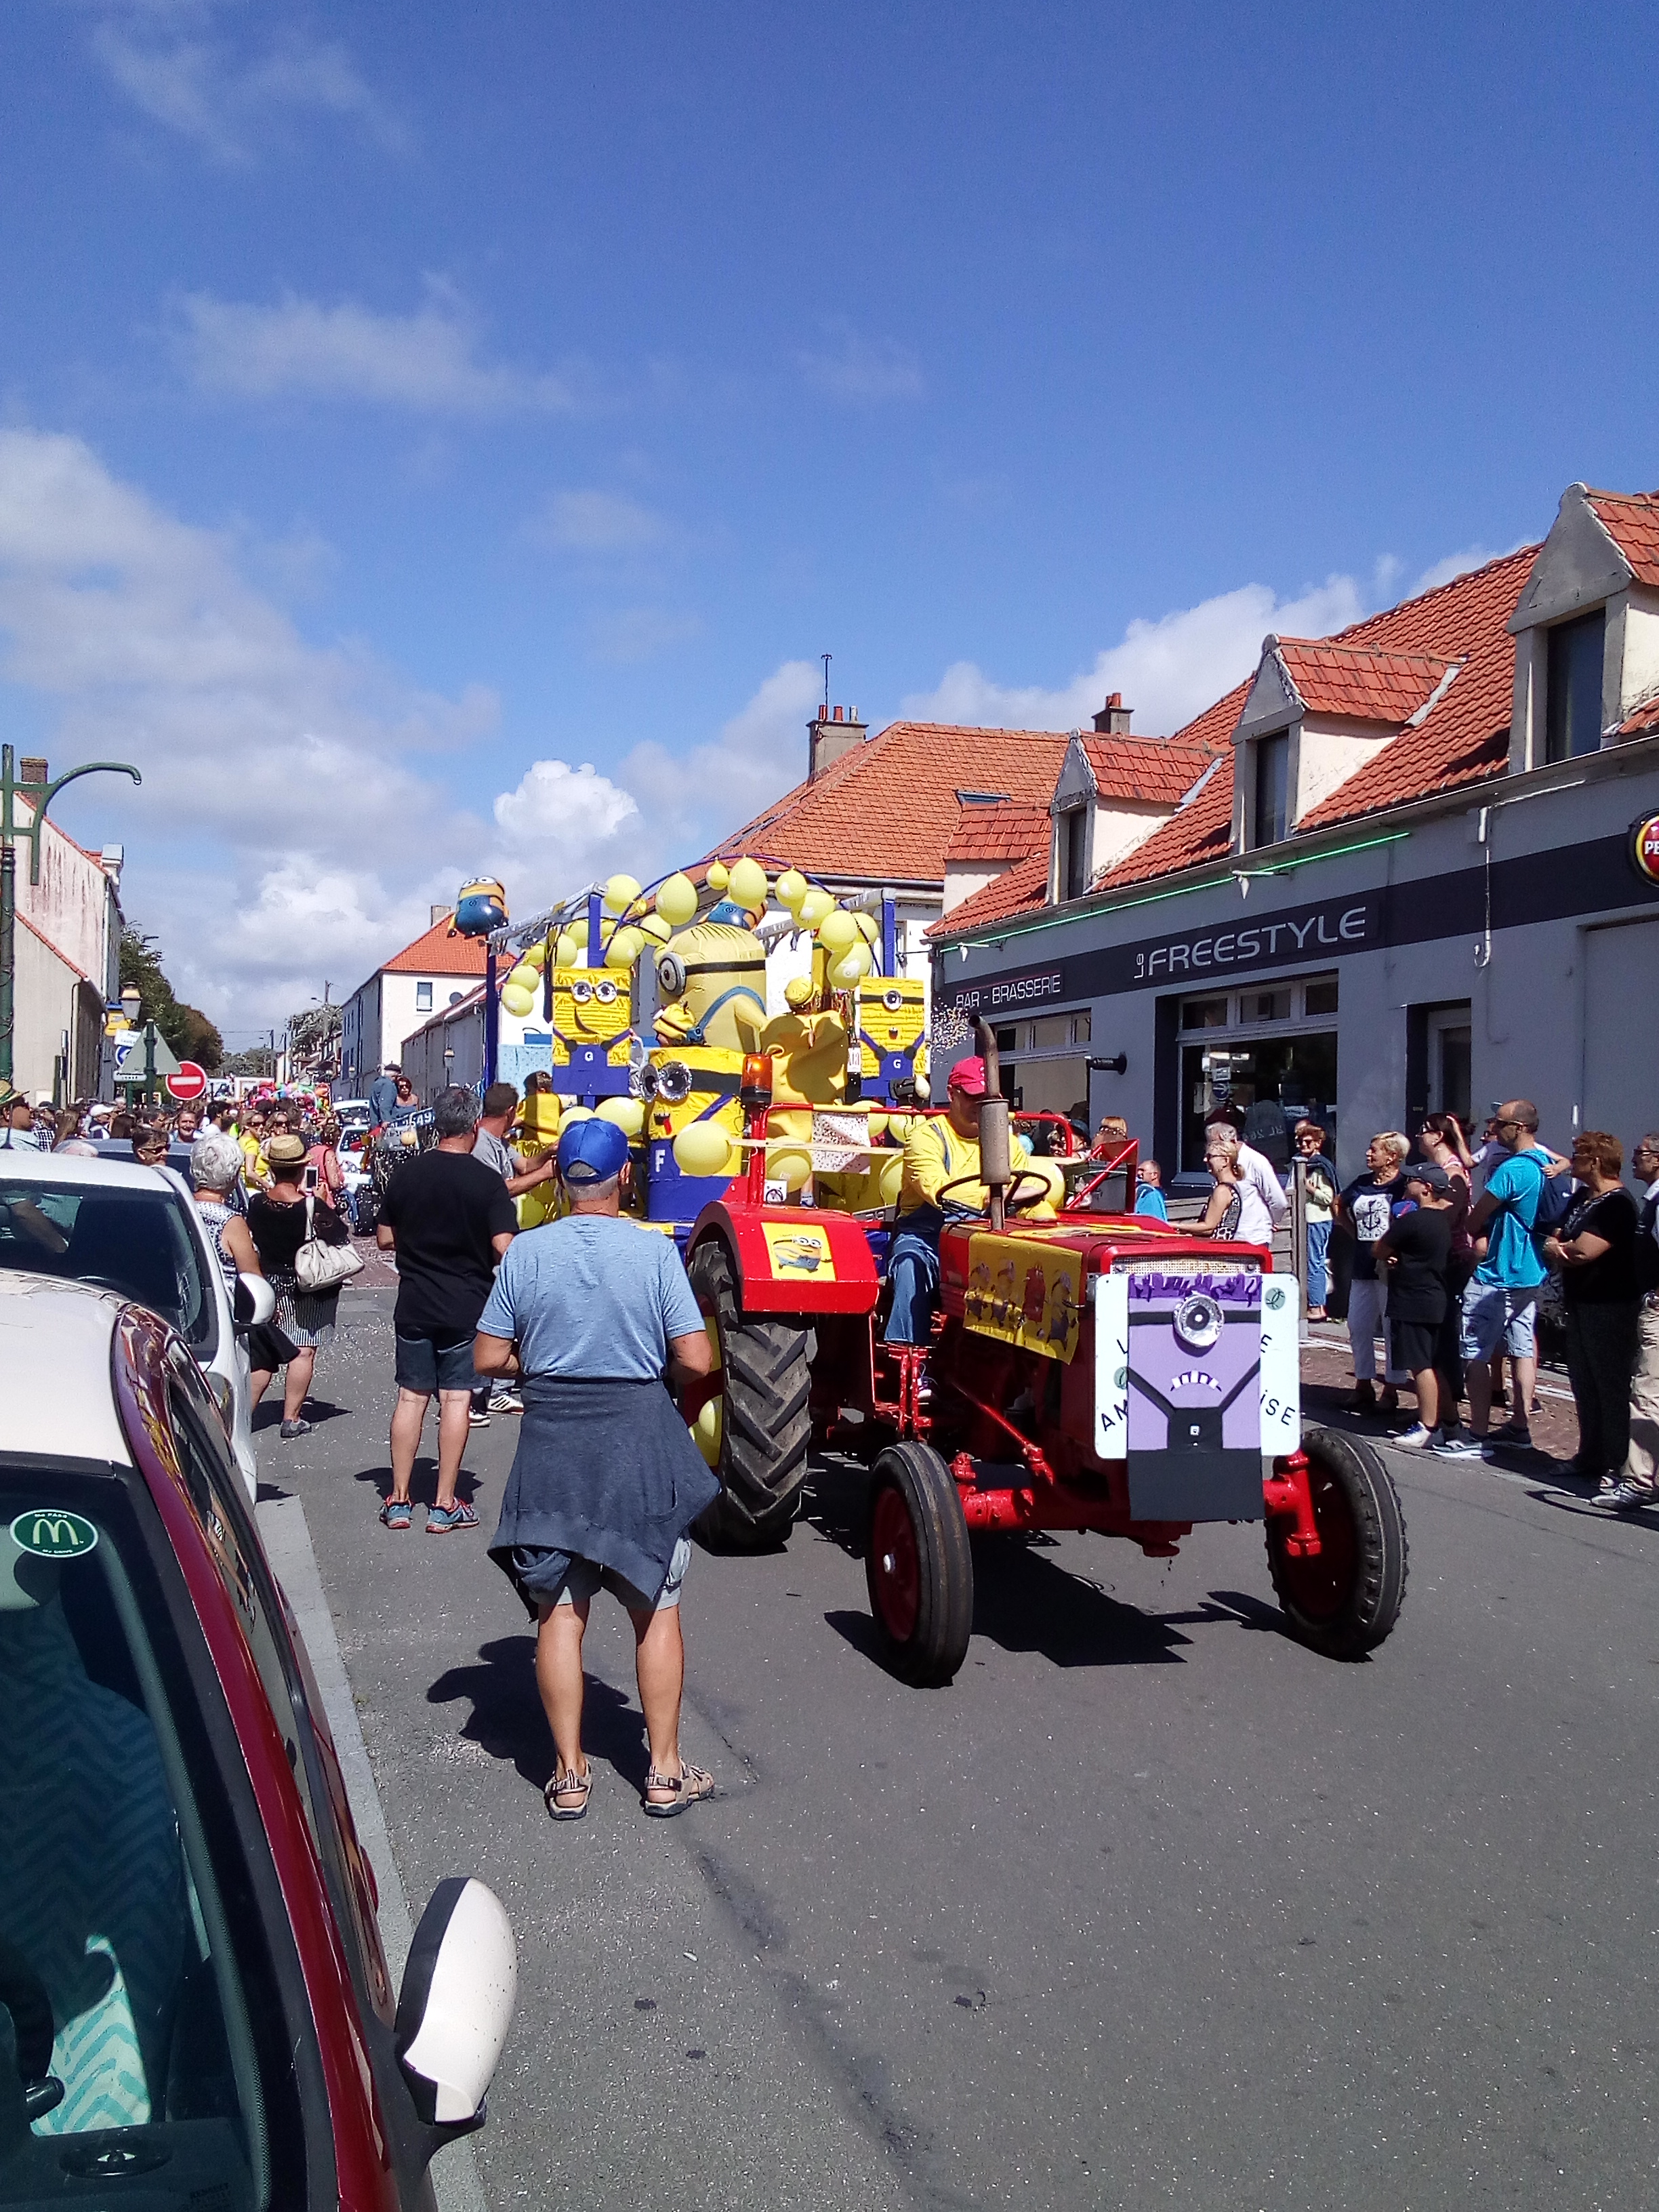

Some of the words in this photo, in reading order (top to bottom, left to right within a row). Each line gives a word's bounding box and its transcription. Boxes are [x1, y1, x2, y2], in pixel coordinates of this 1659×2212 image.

[1134, 954, 1144, 979] Le
[1148, 907, 1366, 976] FREESTYLE
[956, 991, 979, 1008] BAR
[992, 975, 1061, 1004] BRASSERIE
[655, 1149, 665, 1172] F
